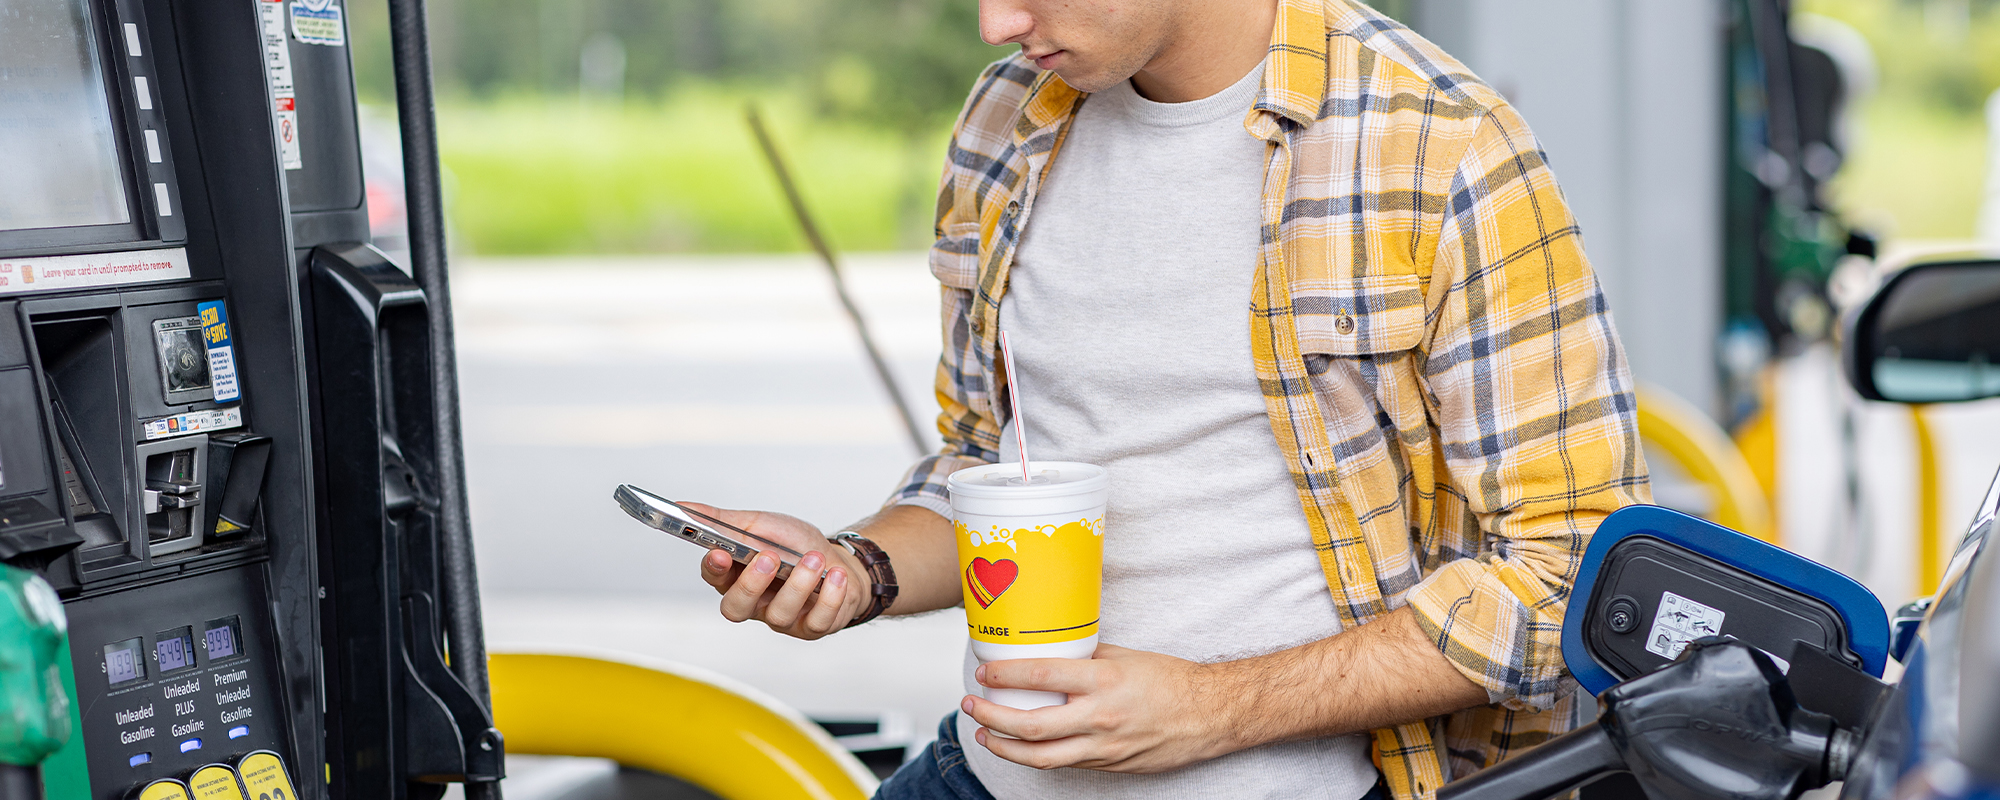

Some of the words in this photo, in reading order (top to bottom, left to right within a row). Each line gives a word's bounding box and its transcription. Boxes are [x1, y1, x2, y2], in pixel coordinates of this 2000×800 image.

[42, 267, 61, 279] Leave
[62, 268, 76, 280] your
[78, 264, 91, 276] card
[92, 264, 98, 275] in
[99, 263, 112, 275] until
[113, 260, 142, 277] prompted
[142, 261, 150, 271] to
[150, 260, 173, 270] remove.
[201, 306, 220, 328] SCAN
[206, 328, 211, 341] &
[210, 322, 228, 344] SAVE
[978, 625, 1010, 636] LARGE
[214, 668, 247, 686] Premium
[163, 678, 200, 700] Unleaded
[216, 684, 251, 706] Unleaded
[116, 704, 154, 726] Unleaded
[175, 700, 195, 717] PLUS
[220, 706, 252, 724] Gasoline
[120, 725, 155, 745] Gasoline
[172, 717, 204, 738] Gasoline
